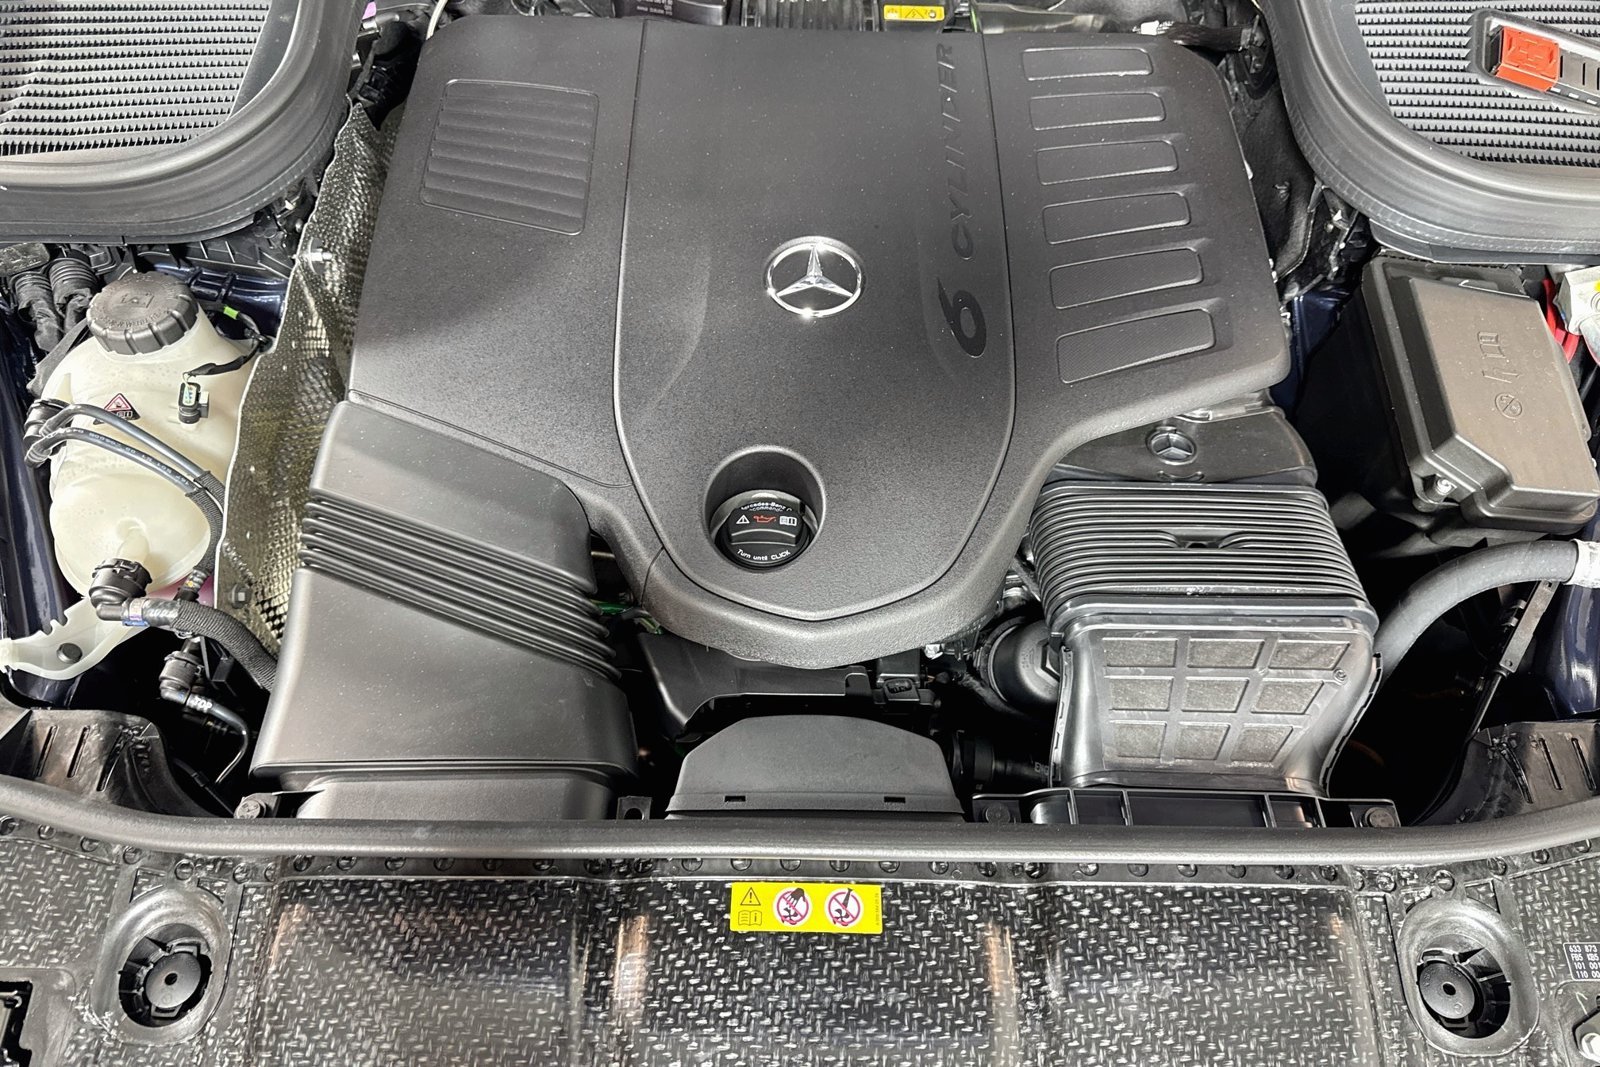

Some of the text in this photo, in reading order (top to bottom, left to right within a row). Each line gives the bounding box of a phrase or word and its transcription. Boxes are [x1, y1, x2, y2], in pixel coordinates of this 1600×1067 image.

[936, 43, 987, 360] 6 CYLINDER
[737, 549, 751, 559] Turn
[770, 549, 791, 560] CLICK
